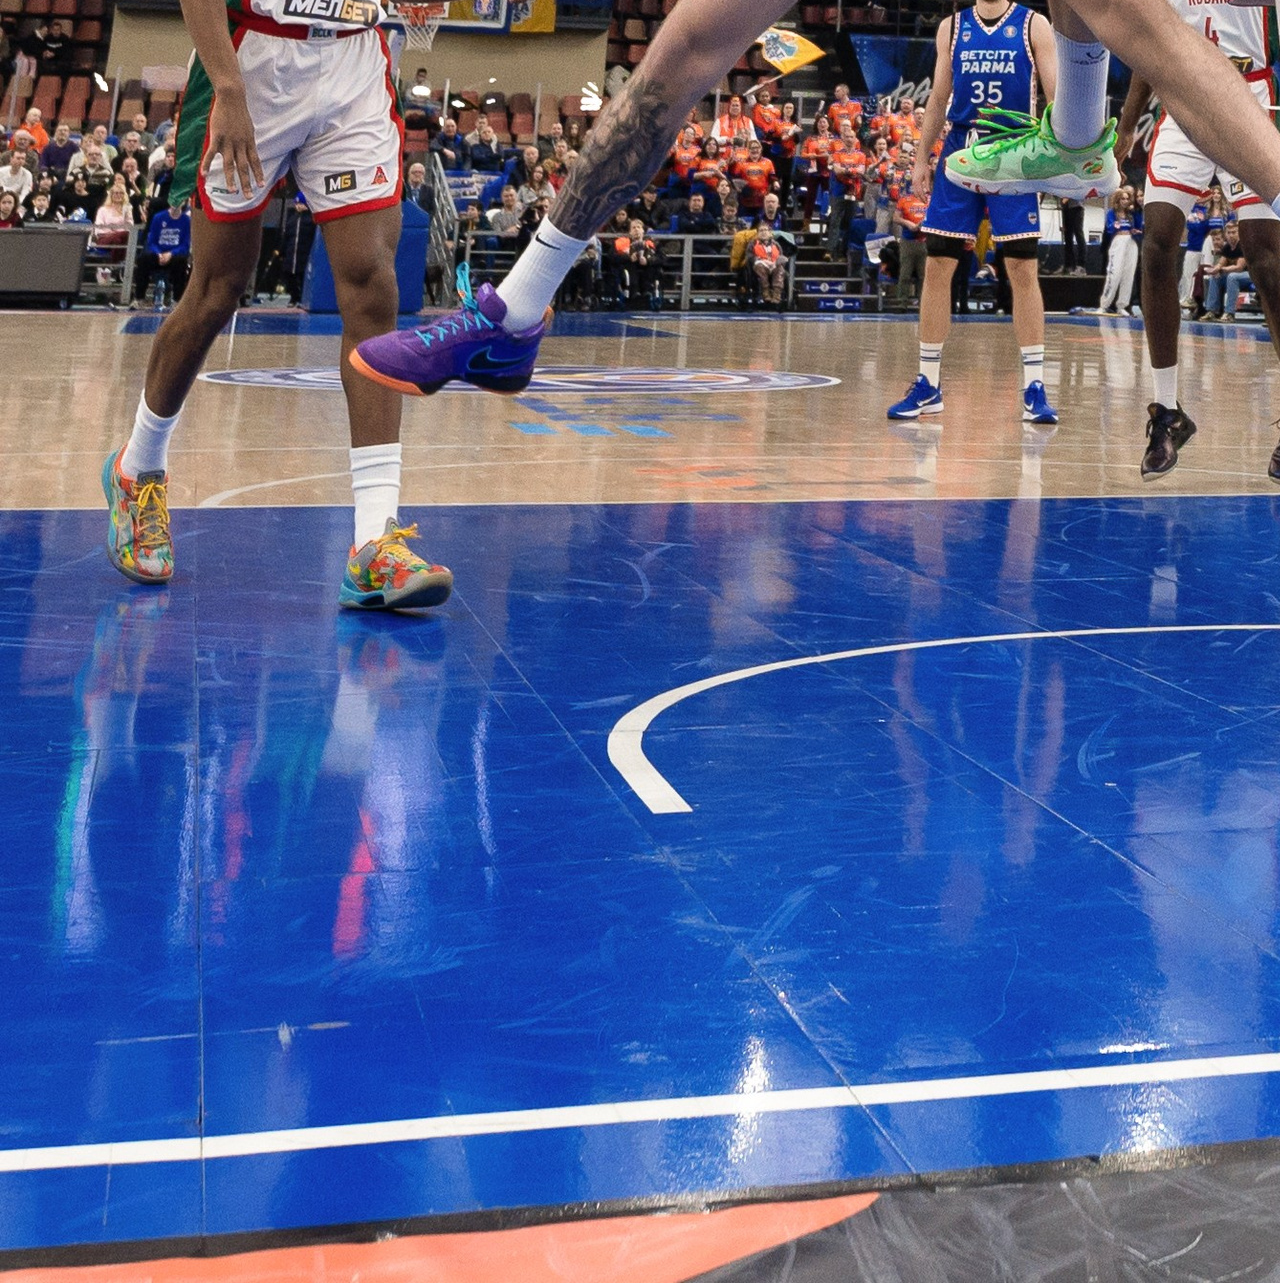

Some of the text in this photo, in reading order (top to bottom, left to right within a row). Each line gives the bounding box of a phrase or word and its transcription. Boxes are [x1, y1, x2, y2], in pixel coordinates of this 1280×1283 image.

[960, 49, 1018, 61] BETCITY
[961, 61, 1016, 74] PARMA
[970, 80, 1003, 104] 35
